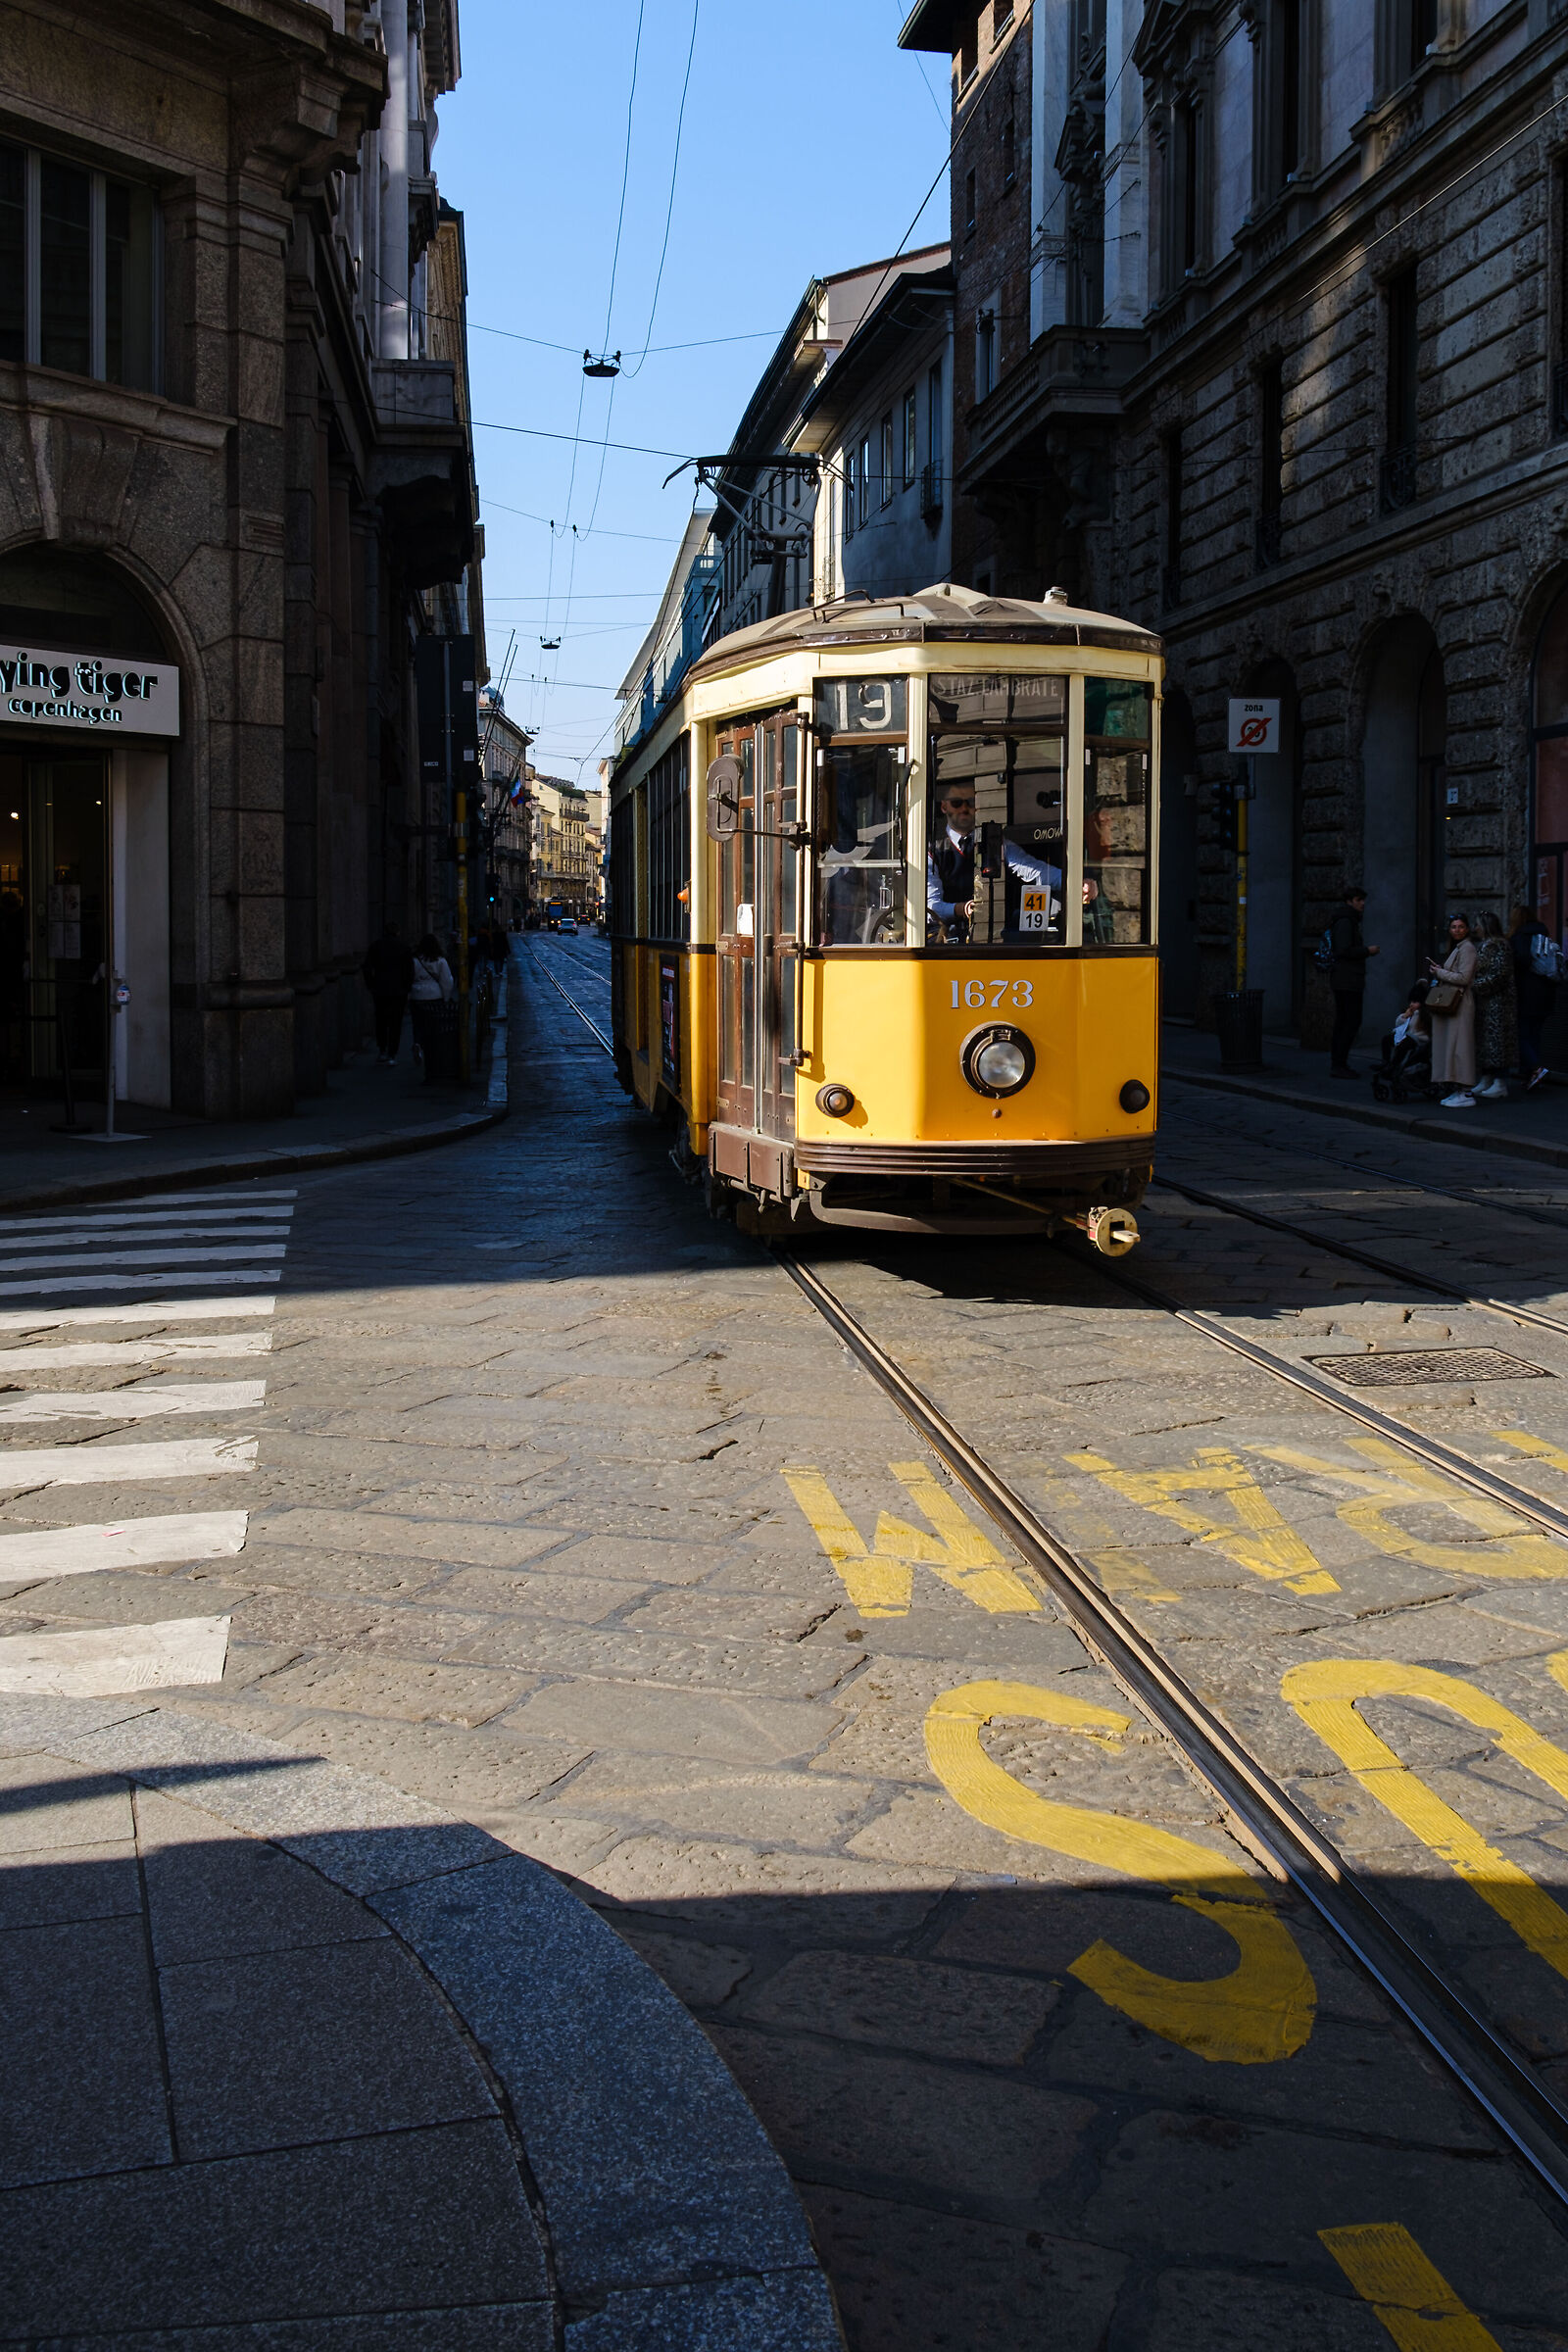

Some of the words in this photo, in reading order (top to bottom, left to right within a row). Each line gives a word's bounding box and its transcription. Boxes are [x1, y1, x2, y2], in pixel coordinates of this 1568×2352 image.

[74, 660, 159, 704] tiger
[8, 698, 123, 725] copenhagen
[838, 678, 891, 730] 19
[1244, 704, 1264, 712] zona
[1025, 894, 1043, 909] 41
[1025, 912, 1043, 928] 19
[950, 979, 1034, 1008] 1673
